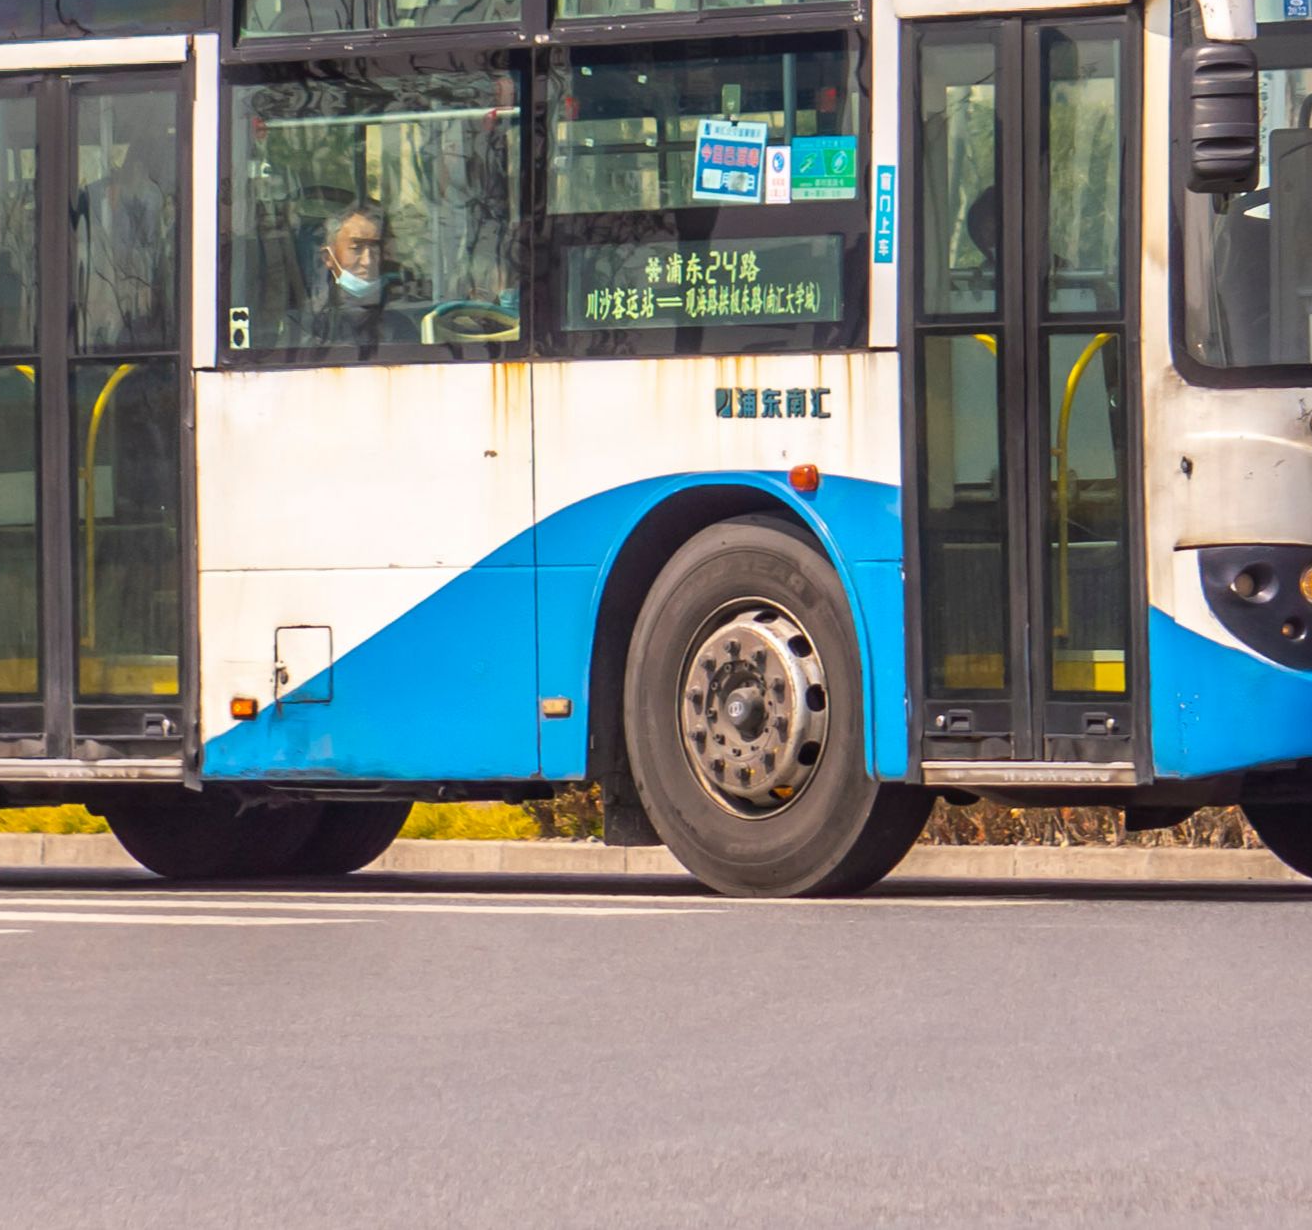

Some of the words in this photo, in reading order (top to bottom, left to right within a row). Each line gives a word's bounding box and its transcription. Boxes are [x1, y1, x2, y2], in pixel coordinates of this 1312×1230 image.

[665, 250, 761, 285] 浦东24路
[735, 387, 831, 419] 浦东南汇
